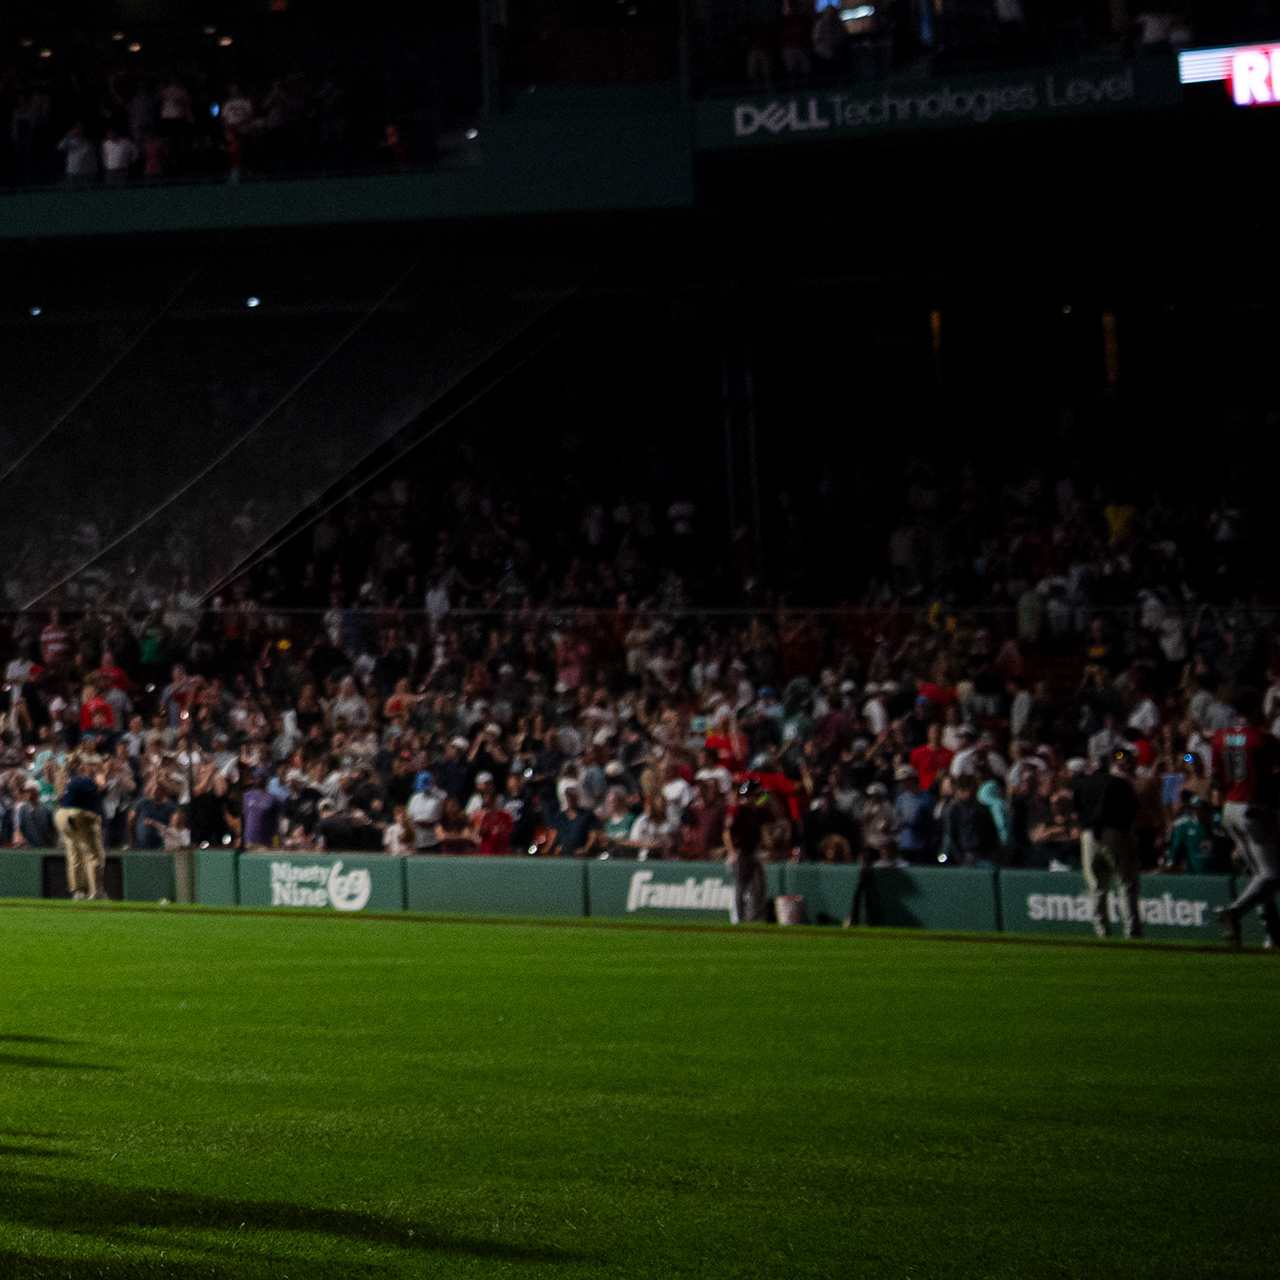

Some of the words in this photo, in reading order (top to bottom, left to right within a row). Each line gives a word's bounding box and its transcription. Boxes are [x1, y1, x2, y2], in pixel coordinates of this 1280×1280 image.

[734, 98, 831, 136] DELL
[832, 83, 1040, 125] Technologies
[1046, 66, 1135, 108] Level
[627, 870, 737, 912] Franklin
